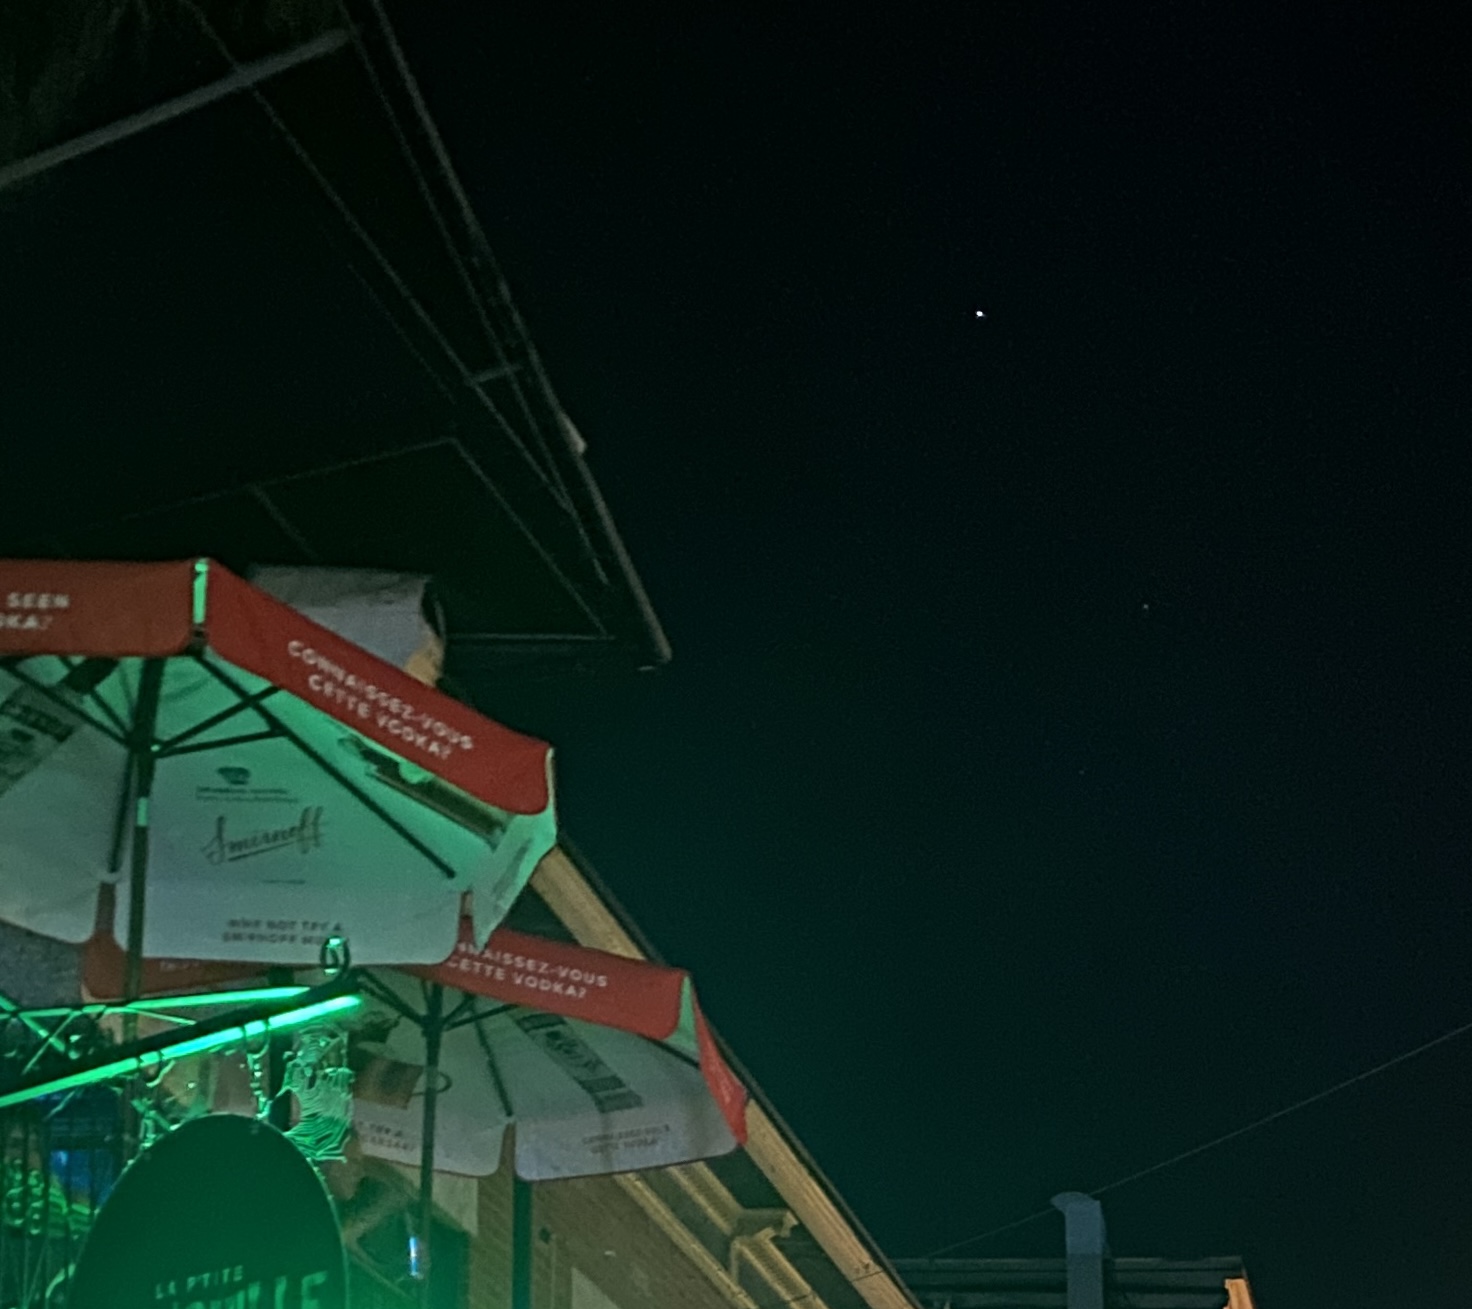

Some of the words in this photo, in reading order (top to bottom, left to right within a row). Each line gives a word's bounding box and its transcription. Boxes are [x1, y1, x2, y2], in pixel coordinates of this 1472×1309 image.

[288, 640, 474, 750] CONNAISSEZ-VOUS
[308, 674, 371, 719] CETTE
[377, 713, 452, 760] VODKA?
[512, 972, 588, 999] VODKA?
[156, 1280, 177, 1300] LA
